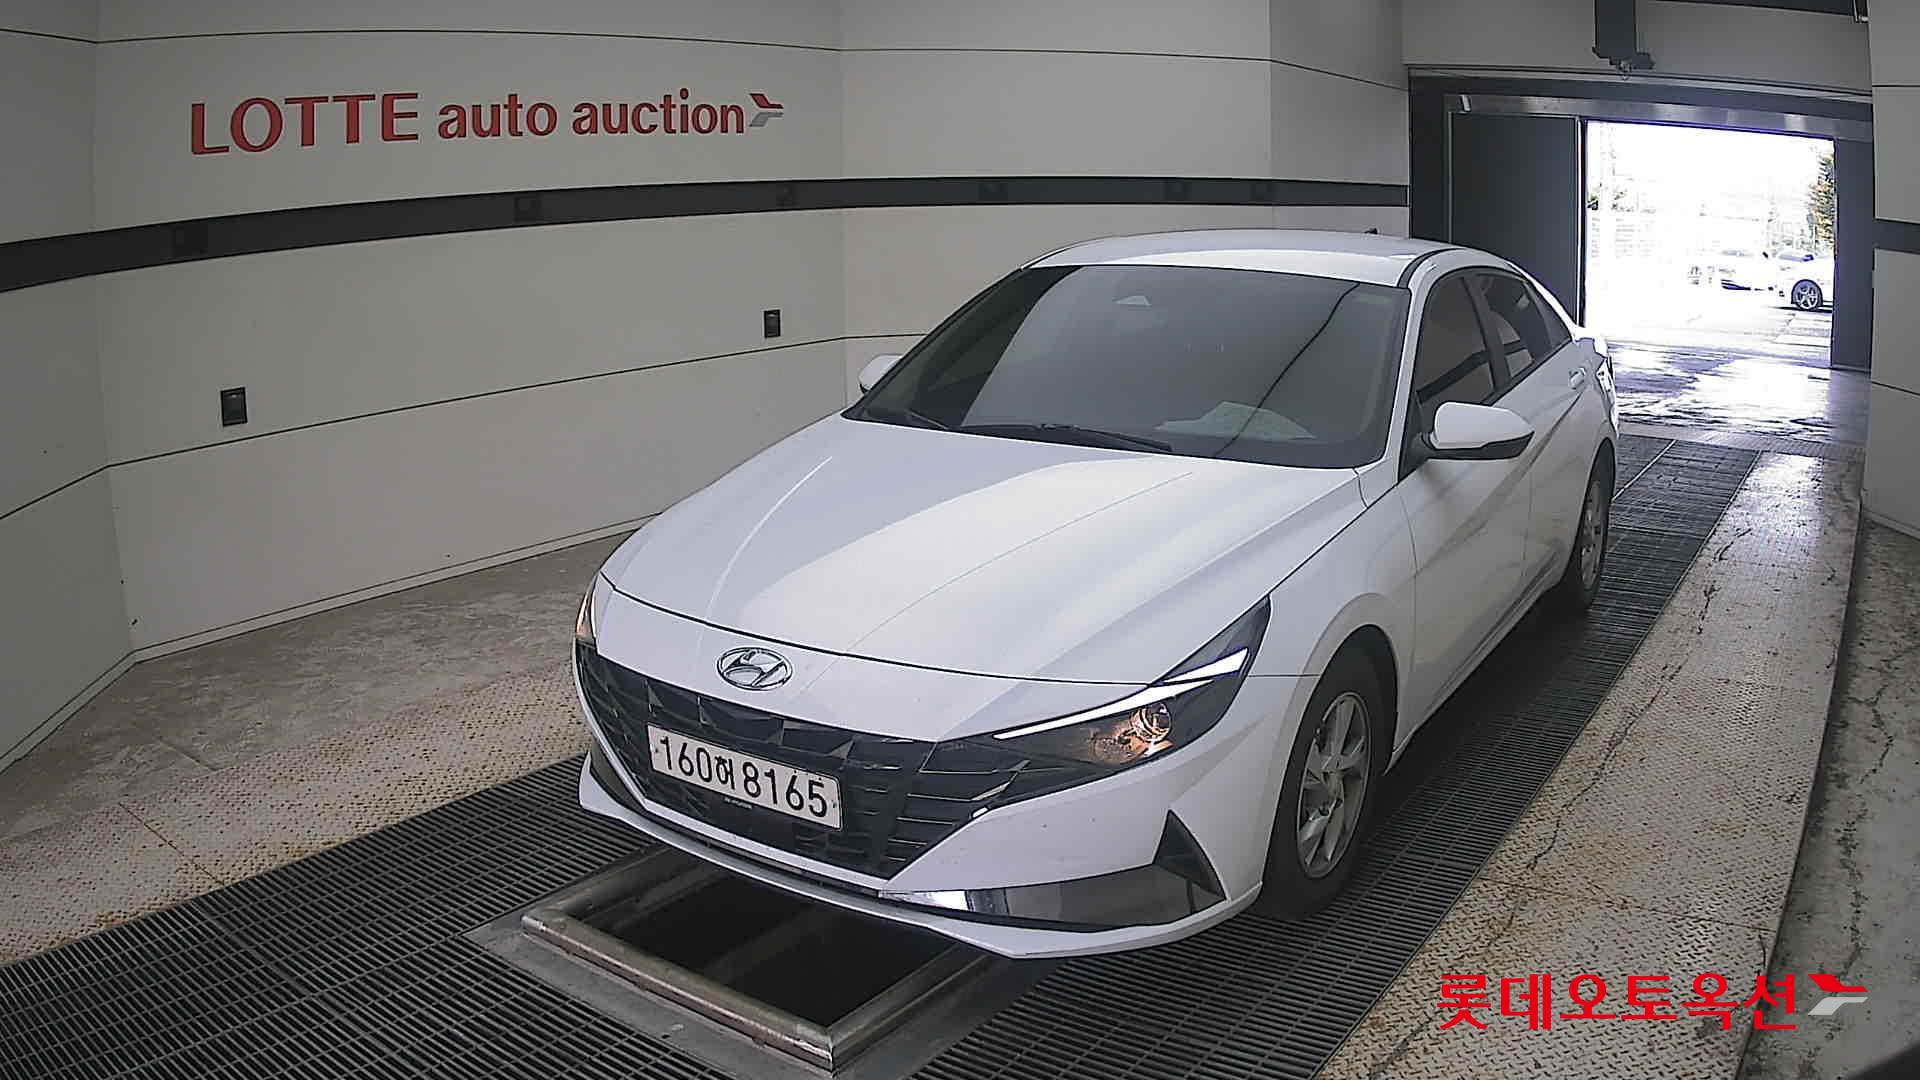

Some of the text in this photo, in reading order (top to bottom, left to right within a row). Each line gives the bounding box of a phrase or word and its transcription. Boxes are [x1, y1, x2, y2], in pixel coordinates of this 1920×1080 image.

[191, 87, 746, 155] LOTTE auto auction
